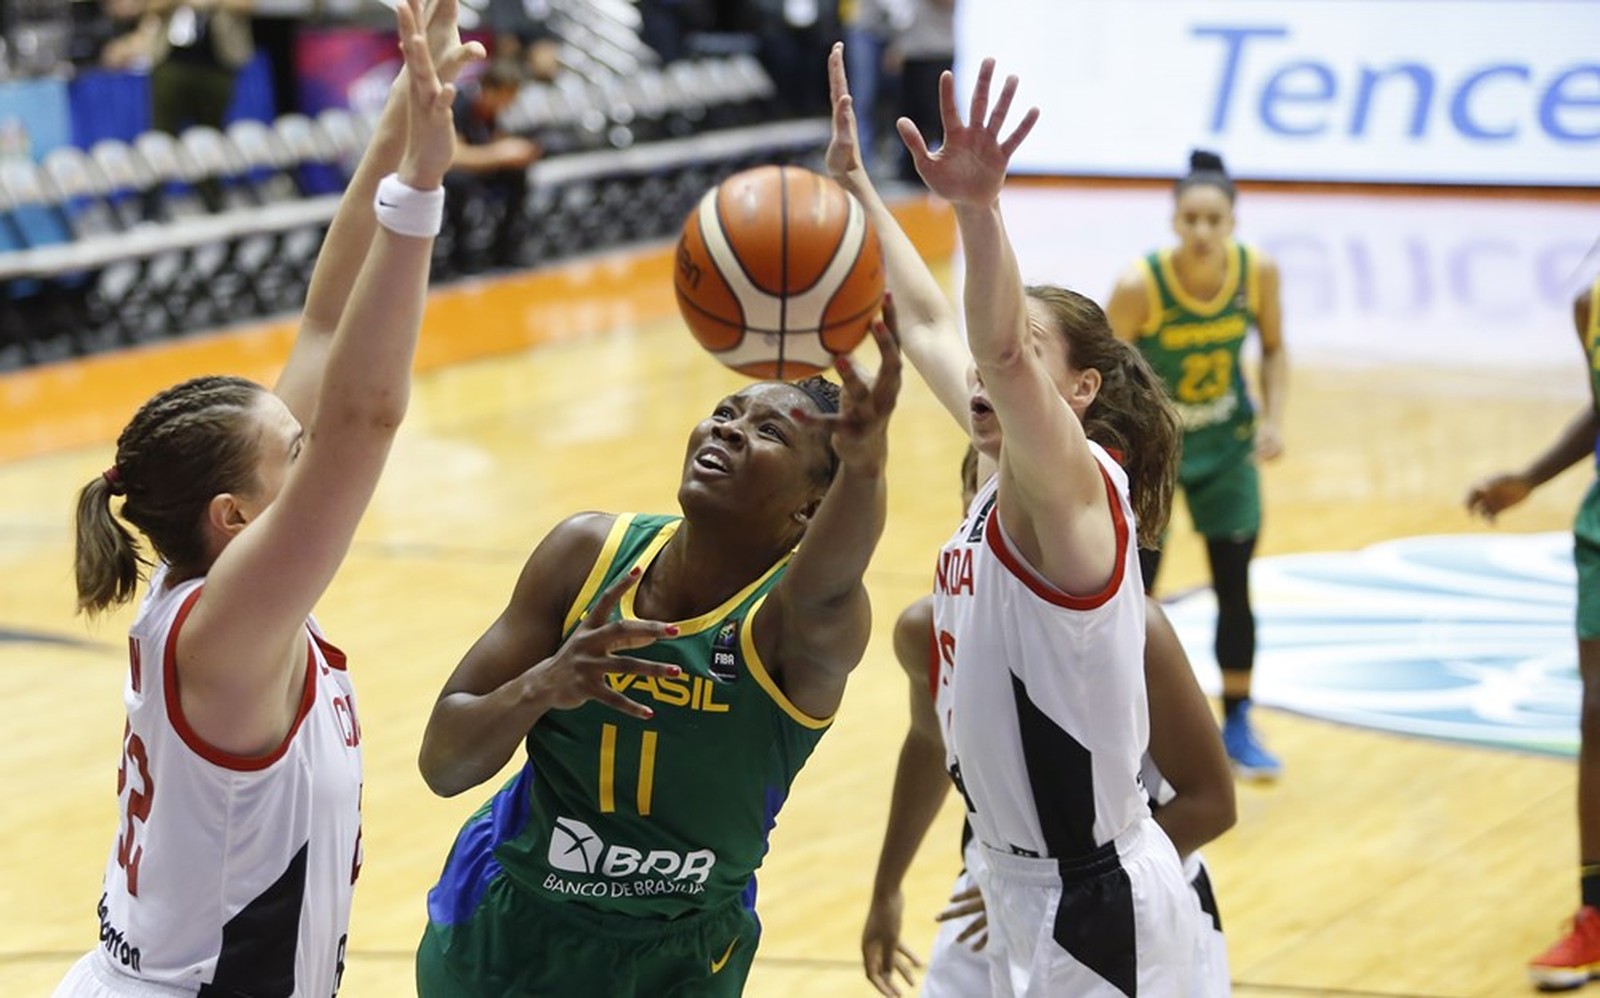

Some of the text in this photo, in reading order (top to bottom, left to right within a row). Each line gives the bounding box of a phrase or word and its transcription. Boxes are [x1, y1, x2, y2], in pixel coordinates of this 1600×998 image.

[1190, 25, 1600, 143] Tence
[1179, 351, 1232, 404] 23
[715, 653, 735, 666] FIBA
[608, 671, 730, 712] ASIL
[600, 723, 658, 816] 11
[542, 873, 607, 897] BANCO
[611, 880, 633, 898] DE
